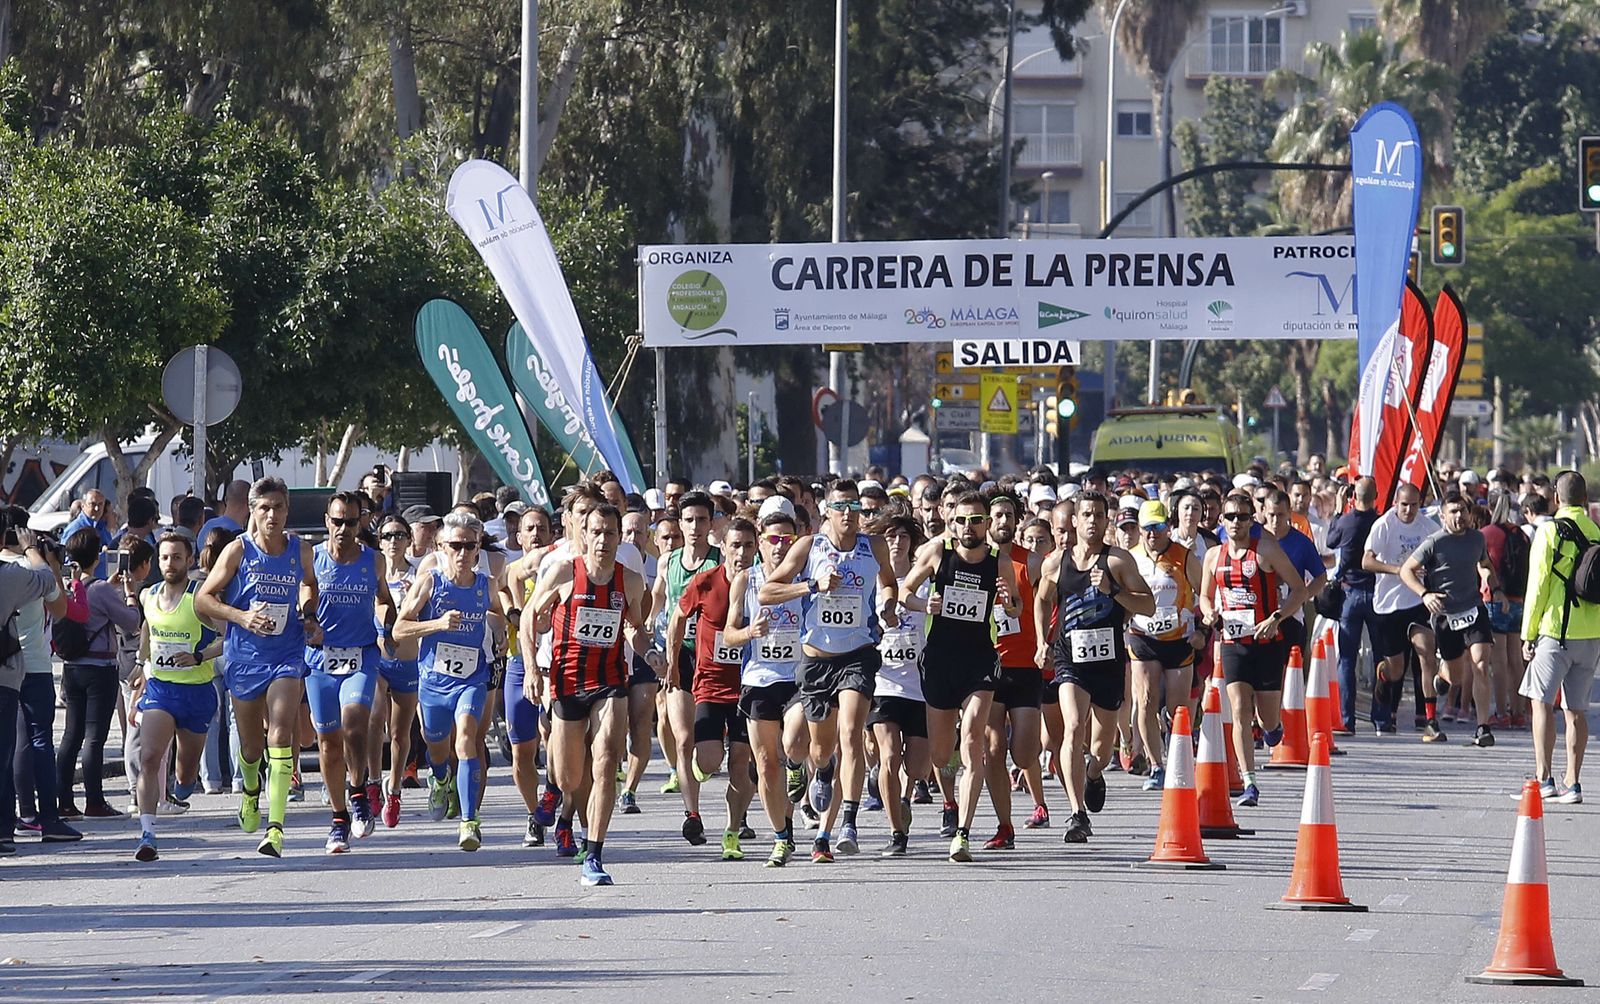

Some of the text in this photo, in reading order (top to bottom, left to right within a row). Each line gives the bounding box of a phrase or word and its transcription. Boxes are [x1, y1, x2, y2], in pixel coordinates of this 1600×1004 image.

[648, 252, 733, 265] ORGANIZA
[771, 253, 1235, 291] CARRERA DE LA PRENSA
[794, 313, 847, 322] Ayuntamiento
[860, 312, 888, 321] Málaga
[950, 305, 1019, 320] MÁLAGA
[822, 324, 851, 332] Deporte
[1160, 322, 1188, 330] Málaga
[1282, 320, 1331, 331] diputación
[1334, 320, 1344, 330] de
[960, 340, 1074, 366] SALIDA
[318, 582, 368, 592] OPTICALAZA
[946, 602, 978, 618] 504
[822, 610, 854, 624] 803
[578, 624, 613, 638] 478
[1147, 620, 1172, 633] 825
[1228, 624, 1244, 636] 37
[160, 630, 190, 640] Running
[718, 648, 743, 660] 56
[762, 646, 794, 659] 552
[884, 648, 916, 660] 446
[1077, 644, 1110, 658] 315
[156, 656, 179, 668] 44
[328, 658, 358, 670] 276
[444, 659, 464, 674] 12
